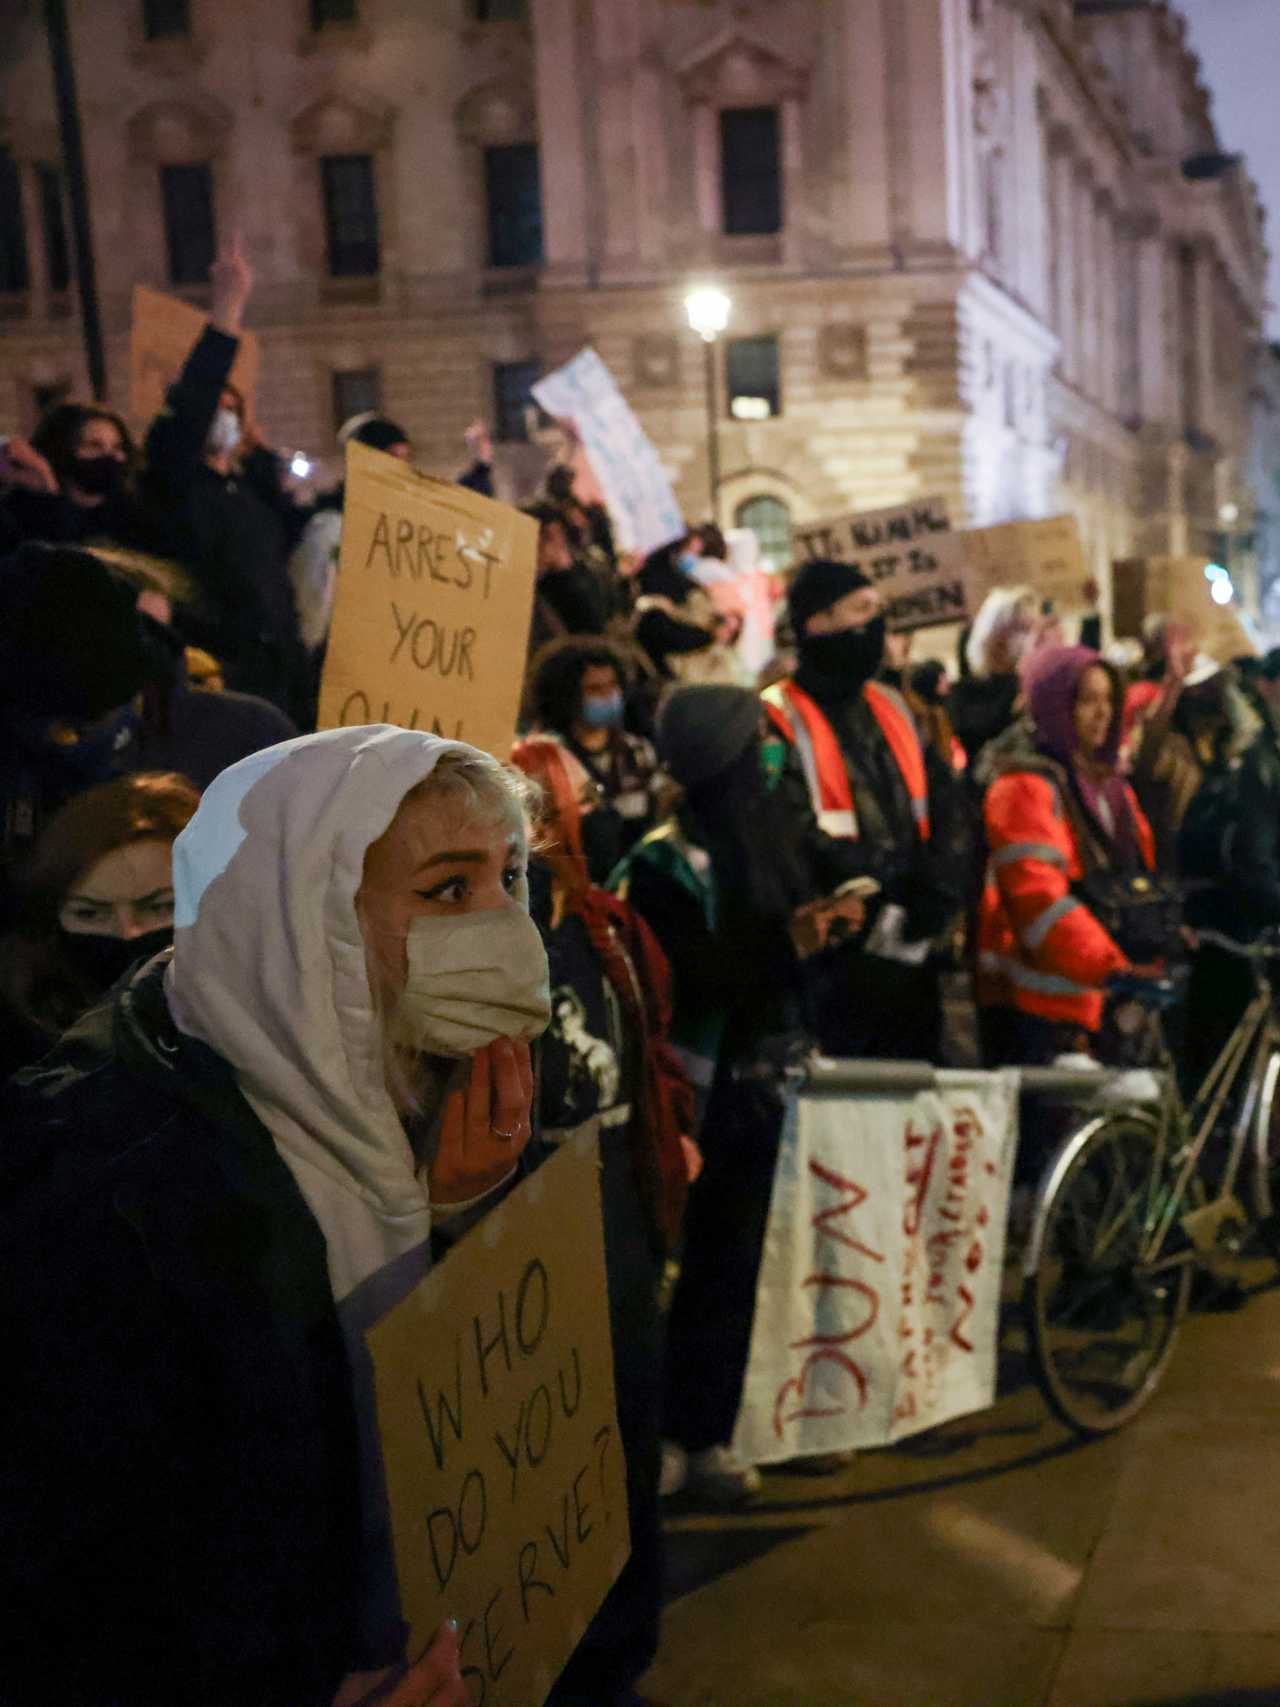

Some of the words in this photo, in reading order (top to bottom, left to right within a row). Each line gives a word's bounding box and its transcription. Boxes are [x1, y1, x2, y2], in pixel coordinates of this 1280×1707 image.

[365, 511, 502, 599] ARREST
[389, 601, 477, 682] YOUR
[416, 1257, 549, 1471] WHO
[426, 1470, 487, 1592] DO
[494, 1346, 583, 1504] YOU
